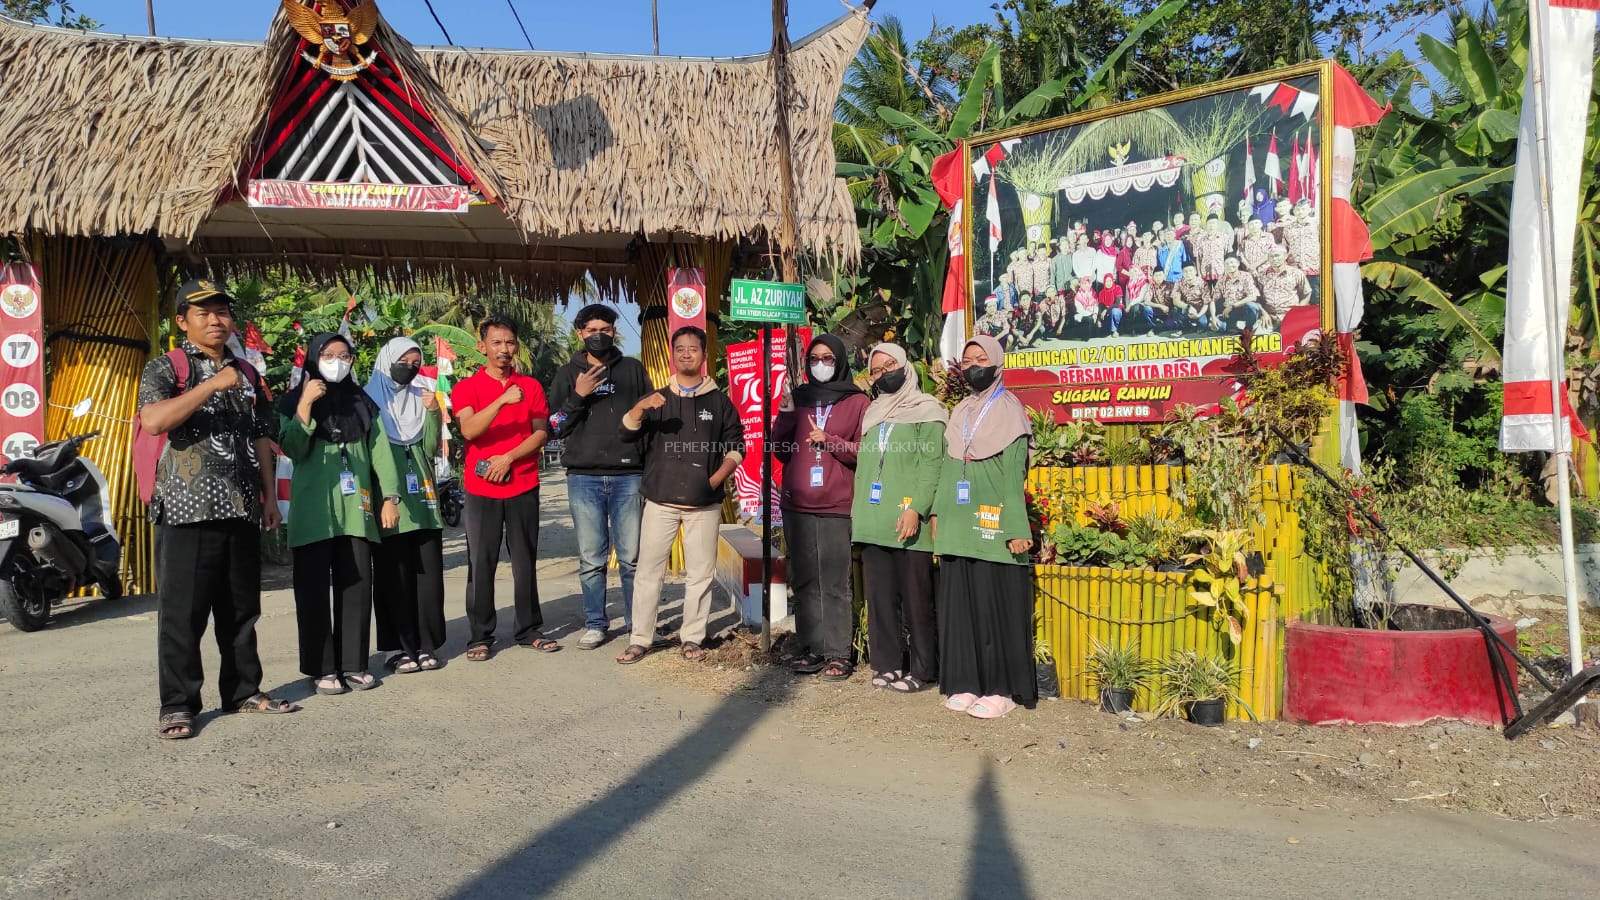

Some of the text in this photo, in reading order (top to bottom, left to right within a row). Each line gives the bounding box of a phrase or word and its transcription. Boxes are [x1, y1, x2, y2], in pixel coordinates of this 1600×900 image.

[735, 287, 802, 308] JL. AZ ZURIYAH
[8, 342, 32, 360] 17
[1004, 349, 1077, 369] INGKUNGAN
[1080, 345, 1125, 363] 02/06
[1059, 361, 1200, 384] BERSAMA KITA BISA
[4, 390, 36, 409] 08
[1052, 386, 1171, 404] SUGENG RAWUH
[1072, 408, 1083, 418] DI
[1100, 407, 1114, 417] 02
[1115, 406, 1133, 417] RW
[1135, 406, 1150, 416] 06
[5, 440, 38, 457] 45
